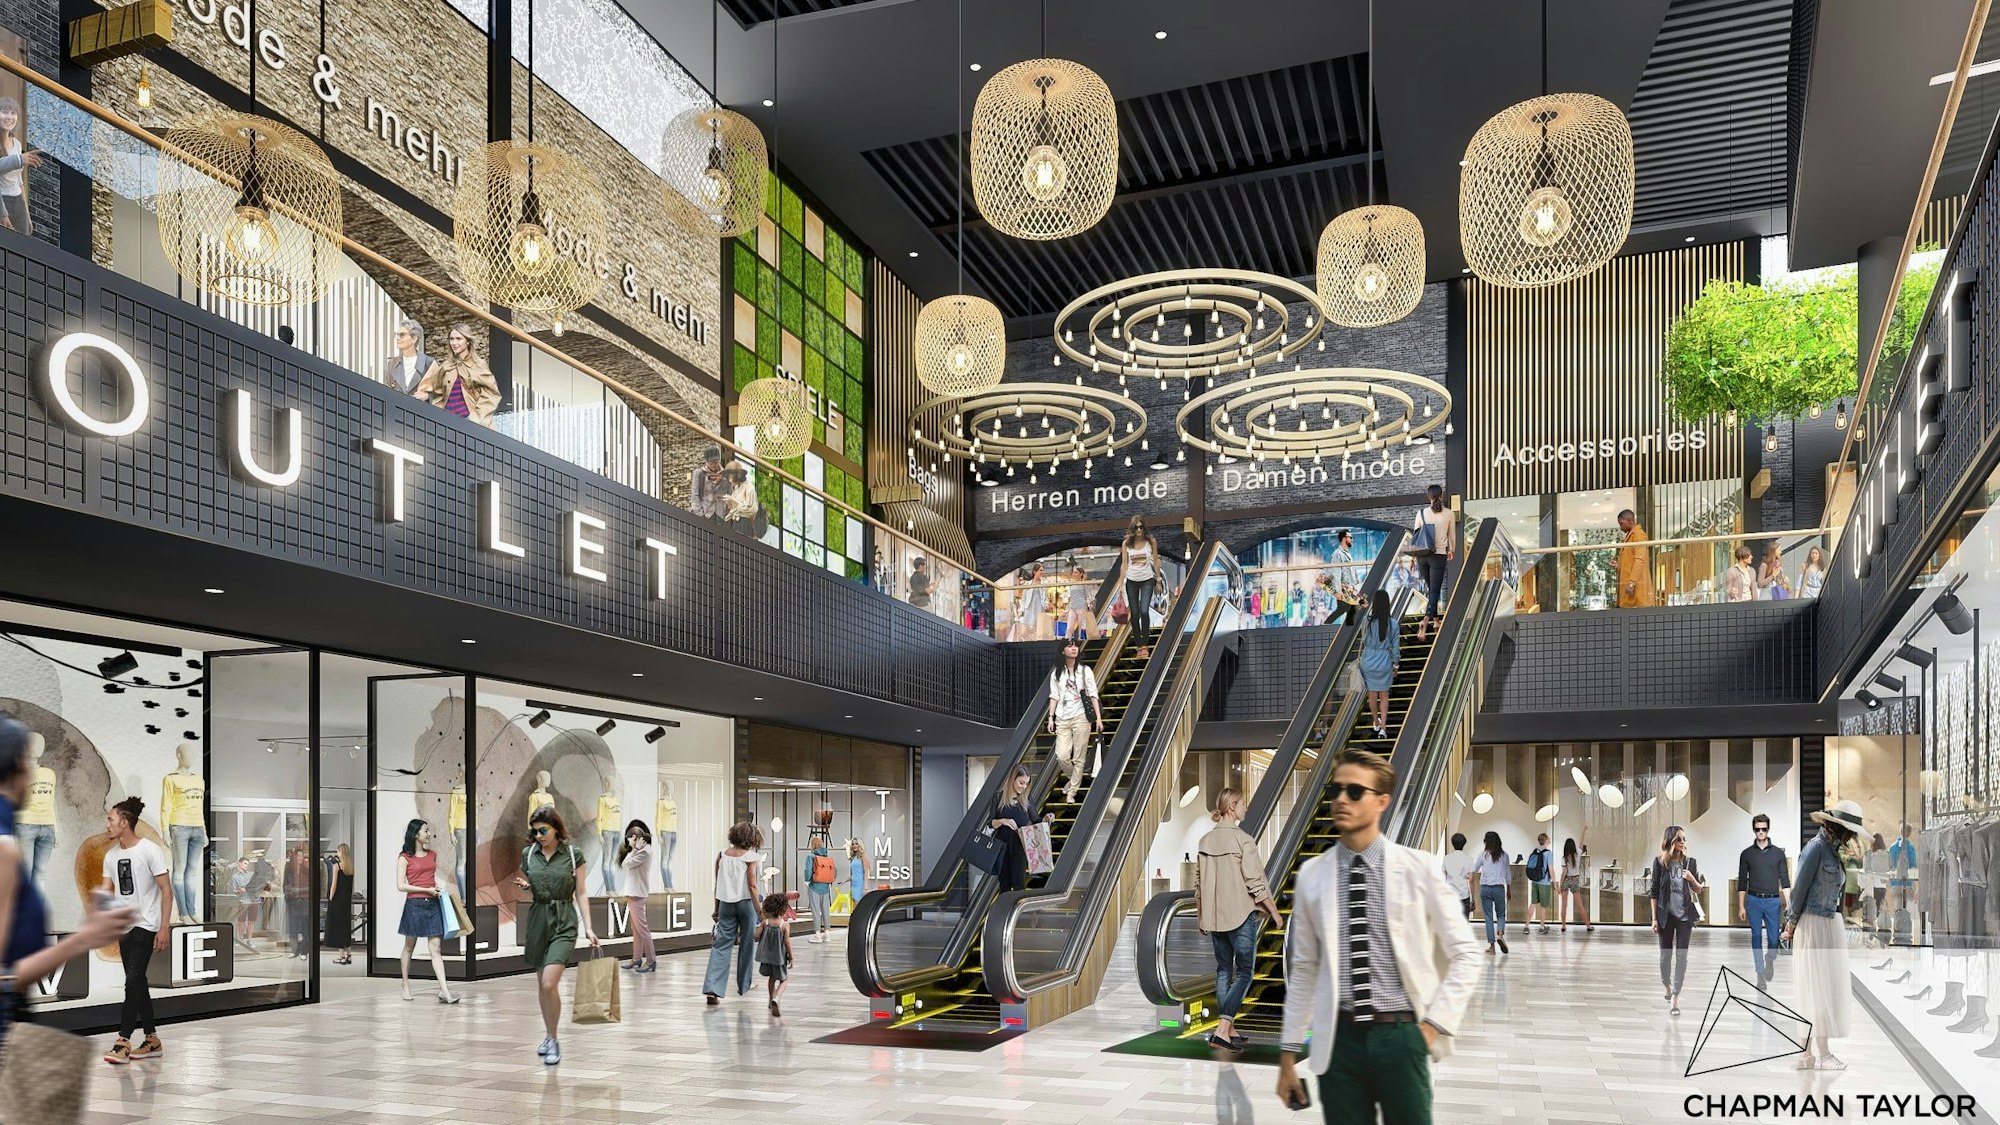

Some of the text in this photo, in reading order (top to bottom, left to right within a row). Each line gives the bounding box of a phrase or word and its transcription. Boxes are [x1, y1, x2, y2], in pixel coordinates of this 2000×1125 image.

[168, 0, 286, 70] ode
[312, 53, 342, 110] &
[543, 208, 709, 346] ode & mehr
[1493, 428, 1707, 468] Accessories
[1853, 268, 1976, 580] OUTLET
[45, 332, 678, 600] OUTLET
[908, 456, 938, 497] Bags
[991, 477, 1168, 513] Herren mode
[1223, 455, 1426, 492] Damen mode
